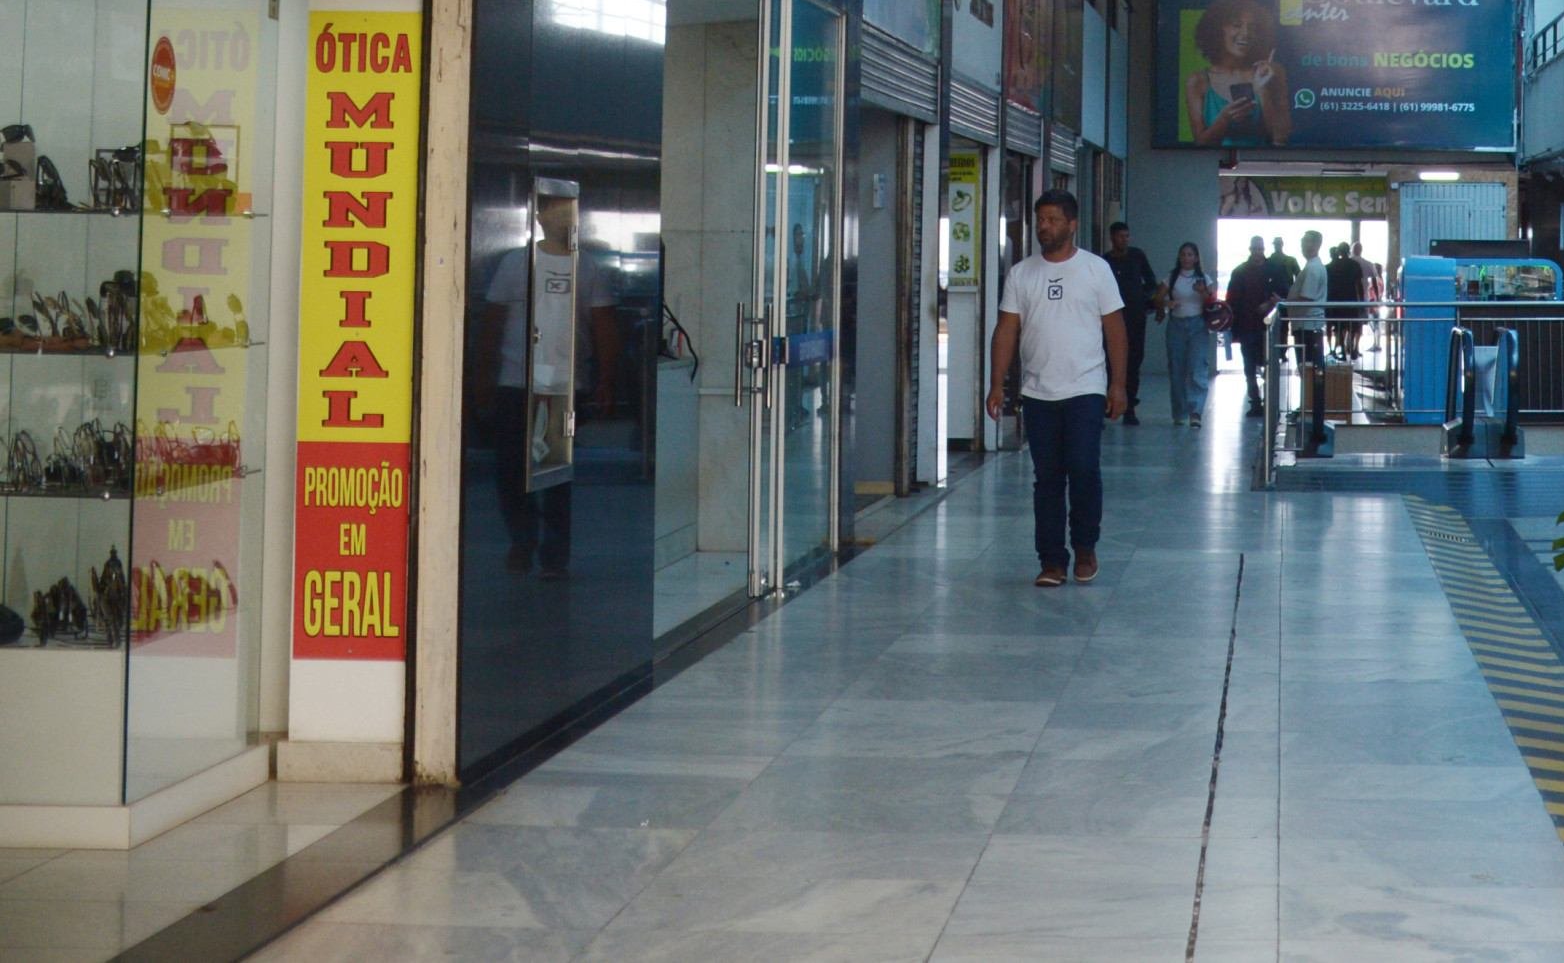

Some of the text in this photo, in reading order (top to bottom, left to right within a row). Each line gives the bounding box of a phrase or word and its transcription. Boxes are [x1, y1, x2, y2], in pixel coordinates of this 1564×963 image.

[315, 22, 413, 74] ÓTICA
[1374, 50, 1475, 69] NEGÓCIOS
[1320, 88, 1371, 98] ANUNCIE
[1320, 102, 1339, 112] (61)
[1400, 102, 1419, 113] (61)
[1270, 191, 1338, 213] Volte
[319, 91, 396, 428] MUNDIAL
[304, 461, 403, 515] PROMOÇÃO
[339, 523, 367, 556] EM
[303, 569, 400, 637] GERAL
